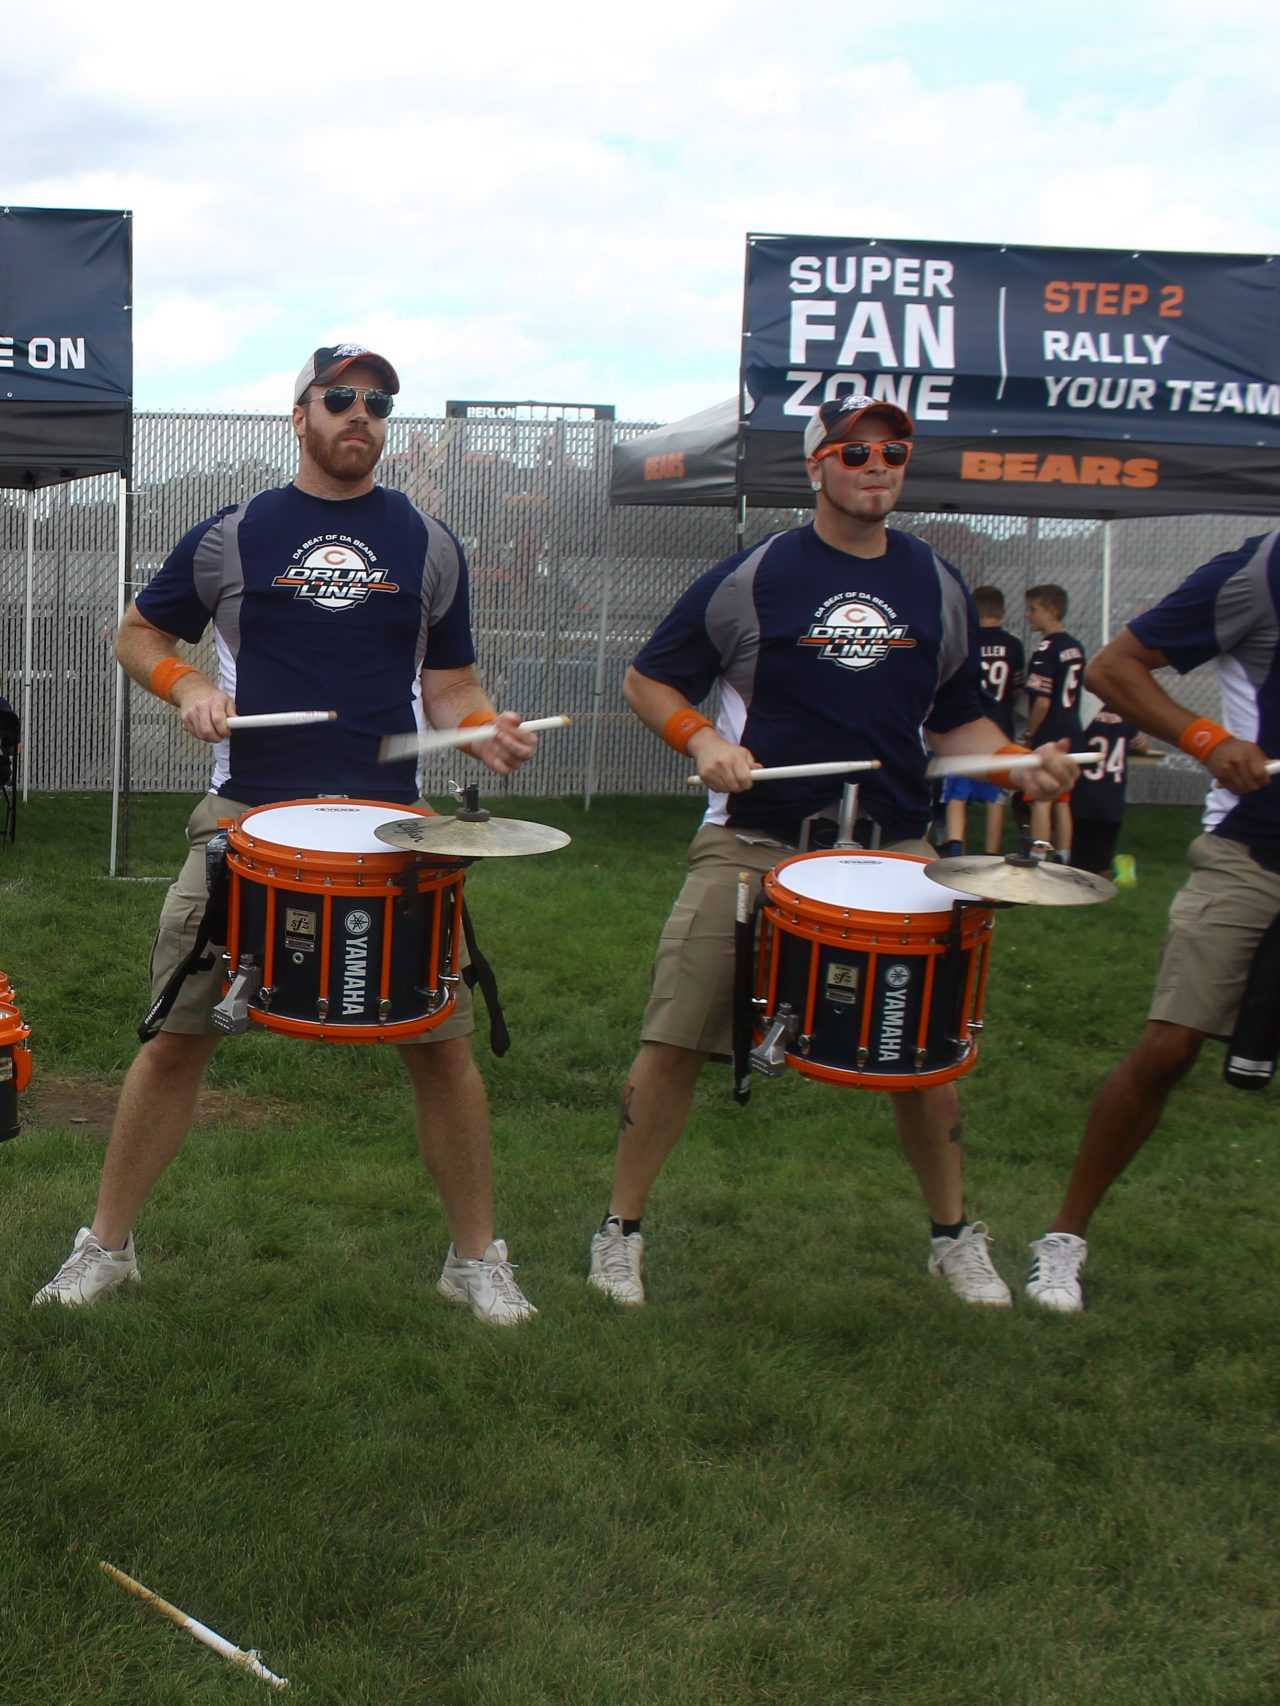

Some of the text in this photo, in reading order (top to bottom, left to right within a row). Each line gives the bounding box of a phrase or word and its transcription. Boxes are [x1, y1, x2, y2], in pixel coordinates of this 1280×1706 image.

[789, 256, 954, 298] SUPER
[1043, 281, 1184, 317] STEP 2
[789, 300, 955, 369] FAN
[1043, 330, 1170, 365] RALLY
[29, 336, 87, 370] ON
[782, 371, 954, 421] ZONE
[1045, 376, 1280, 415] YOUR TEAM
[960, 451, 1159, 487] BEARS
[293, 549, 304, 560] DA
[303, 536, 323, 549] BEAT
[353, 539, 377, 562] BEARS
[288, 569, 383, 583] DRUM
[299, 585, 368, 598] LINE
[814, 607, 825, 618] DA
[824, 593, 843, 607] BEAT
[872, 596, 897, 619] BEARS
[811, 627, 904, 639] DRUM
[824, 645, 888, 656] LINE
[1083, 736, 1126, 784] 34
[342, 936, 368, 1016] YAMAHA
[878, 989, 908, 1062] YAMAHA
